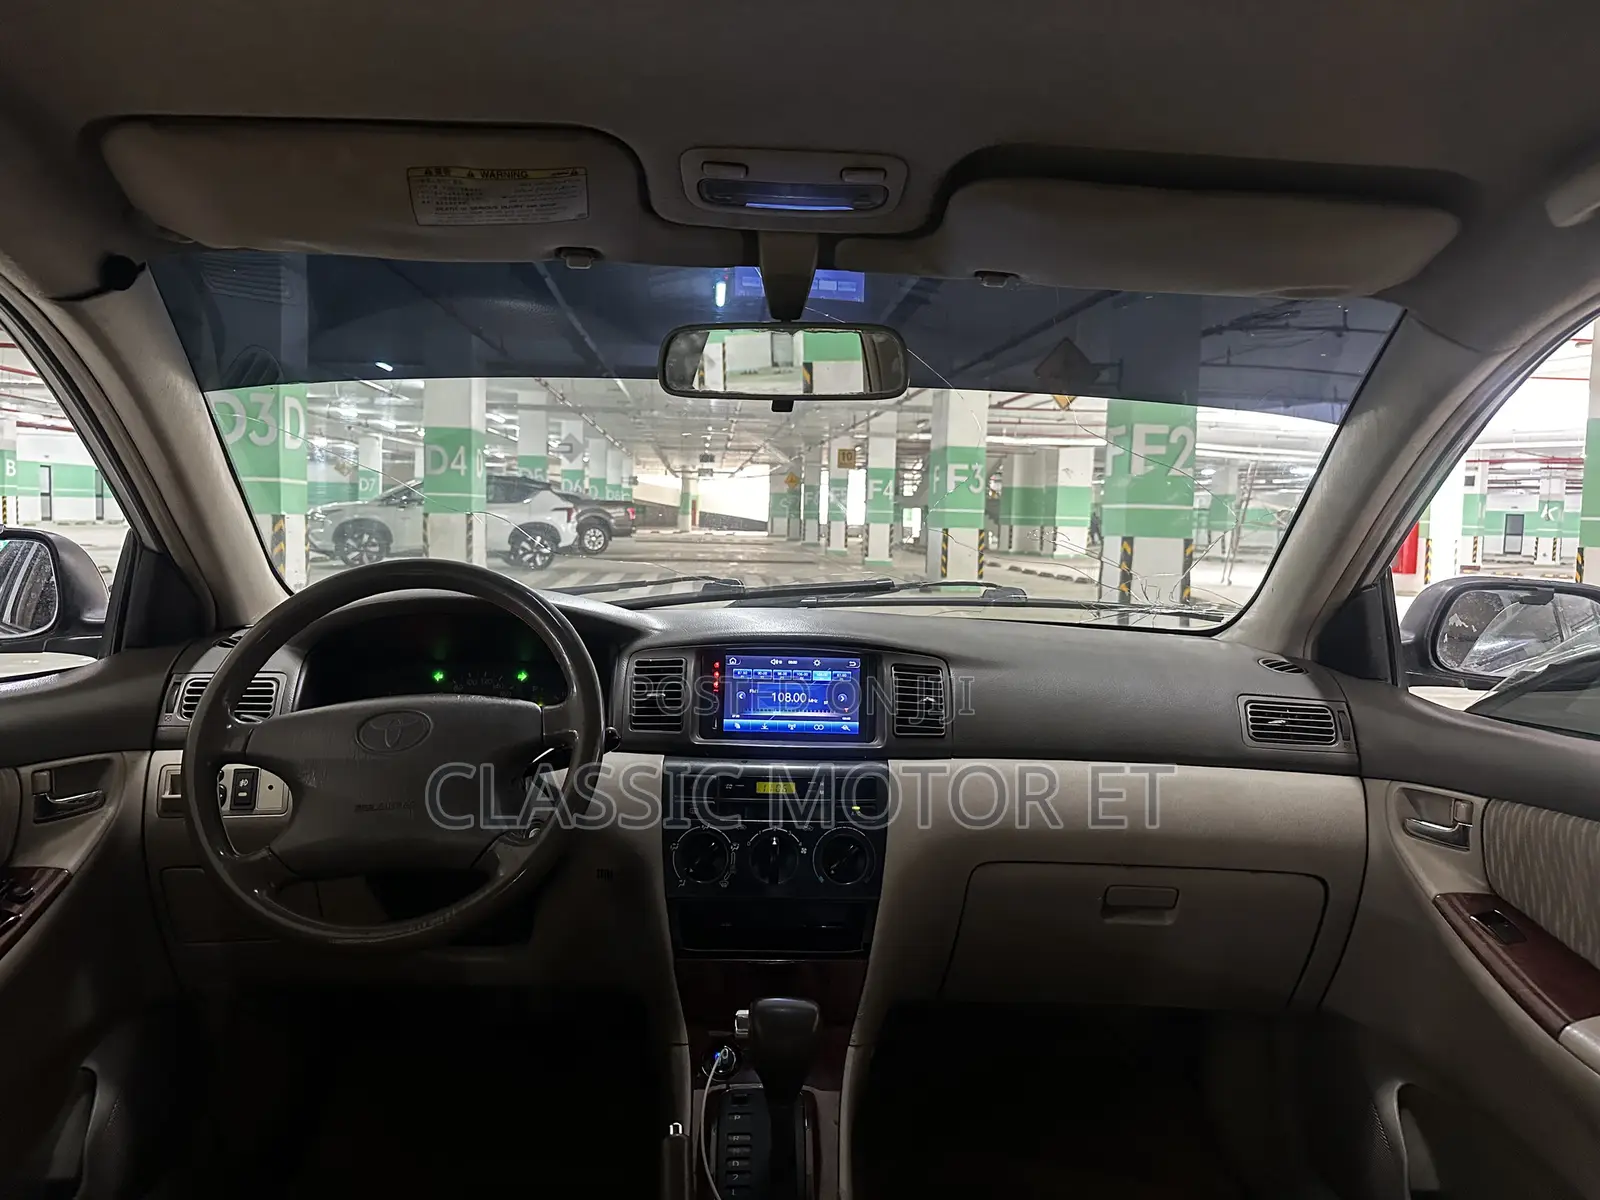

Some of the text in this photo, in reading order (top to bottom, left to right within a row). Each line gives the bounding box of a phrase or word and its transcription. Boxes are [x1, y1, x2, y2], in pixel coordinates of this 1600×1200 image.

[480, 169, 529, 179] WARNING
[842, 450, 853, 462] 10
[1131, 423, 1195, 477] F2
[6, 459, 17, 477] B
[425, 444, 468, 477] D4
[359, 477, 377, 492] D7
[947, 463, 985, 494] F3
[868, 479, 894, 500] F4
[1540, 504, 1558, 522] K
[771, 692, 807, 703] 108.00
